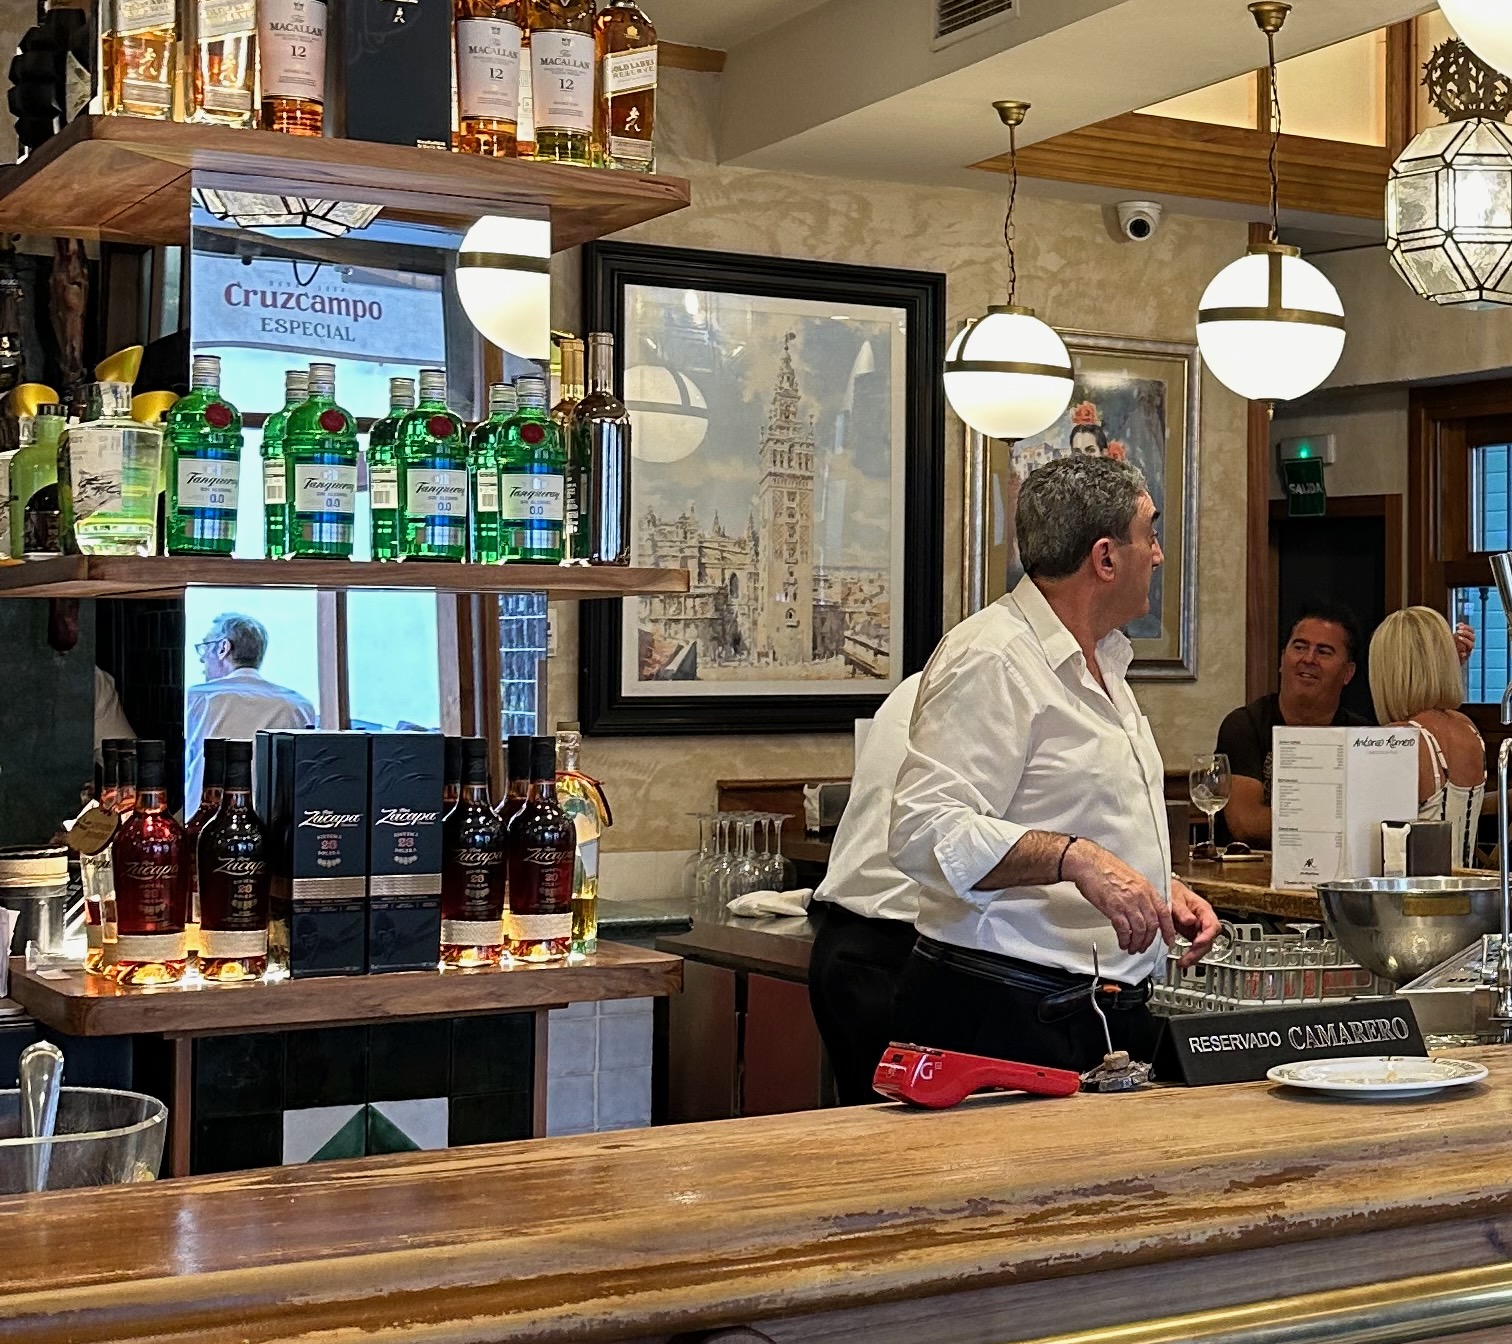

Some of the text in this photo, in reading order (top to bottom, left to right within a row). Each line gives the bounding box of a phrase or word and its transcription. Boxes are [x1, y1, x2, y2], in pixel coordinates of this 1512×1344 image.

[291, 45, 306, 57] 12
[490, 67, 504, 80] 12
[559, 78, 574, 90] 12
[224, 281, 382, 322] Cruzcampo
[260, 317, 356, 342] ESPECIAL
[1289, 482, 1323, 494] SALIDA
[298, 811, 364, 828] Zacapa
[375, 808, 440, 826] Zacapa
[1188, 1016, 1409, 1053] RESERVADO CAMARERO
